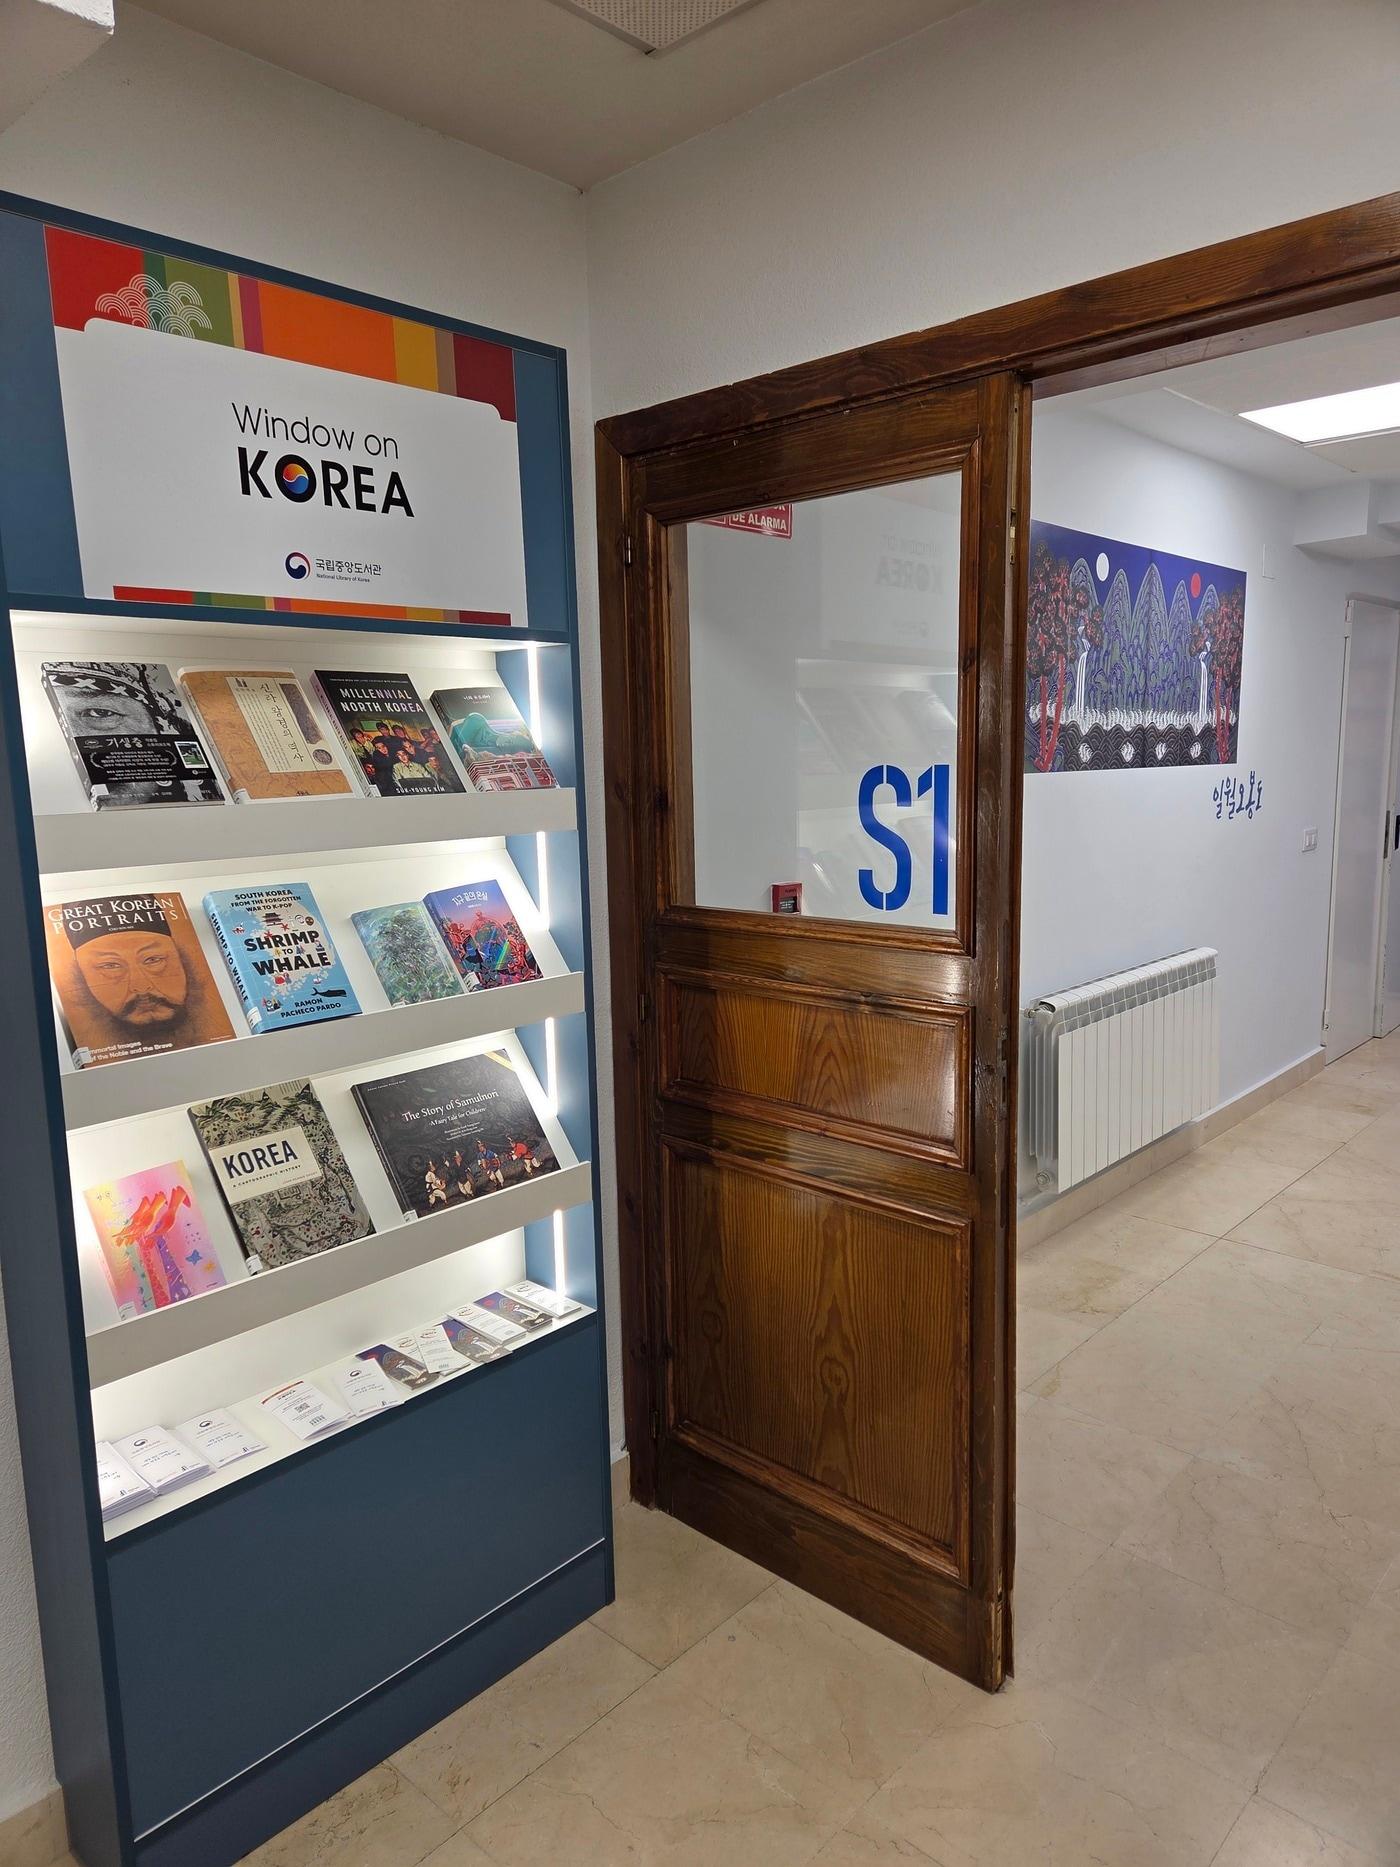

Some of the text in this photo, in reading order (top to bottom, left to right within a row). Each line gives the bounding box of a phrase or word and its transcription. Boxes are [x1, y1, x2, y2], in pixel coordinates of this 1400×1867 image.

[232, 403, 398, 459] Window on
[237, 446, 415, 518] KOREA
[748, 513, 787, 531] ALARMA
[316, 558, 382, 576] 국립중앙도서관
[340, 688, 412, 699] MILLENNIAL
[340, 702, 424, 712] NORTH KOREA
[106, 737, 143, 748] 기생충
[857, 763, 950, 916] S1
[231, 900, 250, 908] FROM
[264, 895, 301, 904] FORGOTTEN
[234, 889, 293, 900] SOUTH KOREA
[452, 894, 464, 907] 지구
[48, 898, 174, 922] GREAT KOREAN
[53, 909, 178, 934] PORTRAITS
[244, 930, 319, 952] SHRIMP
[211, 913, 249, 1002] SHRIMP TO WHALE
[252, 952, 331, 976] WHALE
[281, 1002, 341, 1018] PACHECO PARDO
[294, 998, 323, 1008] RAMON
[109, 1050, 129, 1058] Noble
[154, 1042, 173, 1051] Brave
[118, 1041, 142, 1050] Images
[402, 1089, 499, 1122] The Story of Samulnori
[222, 1140, 298, 1179] KOREA
[280, 1164, 301, 1174] HISTORY
